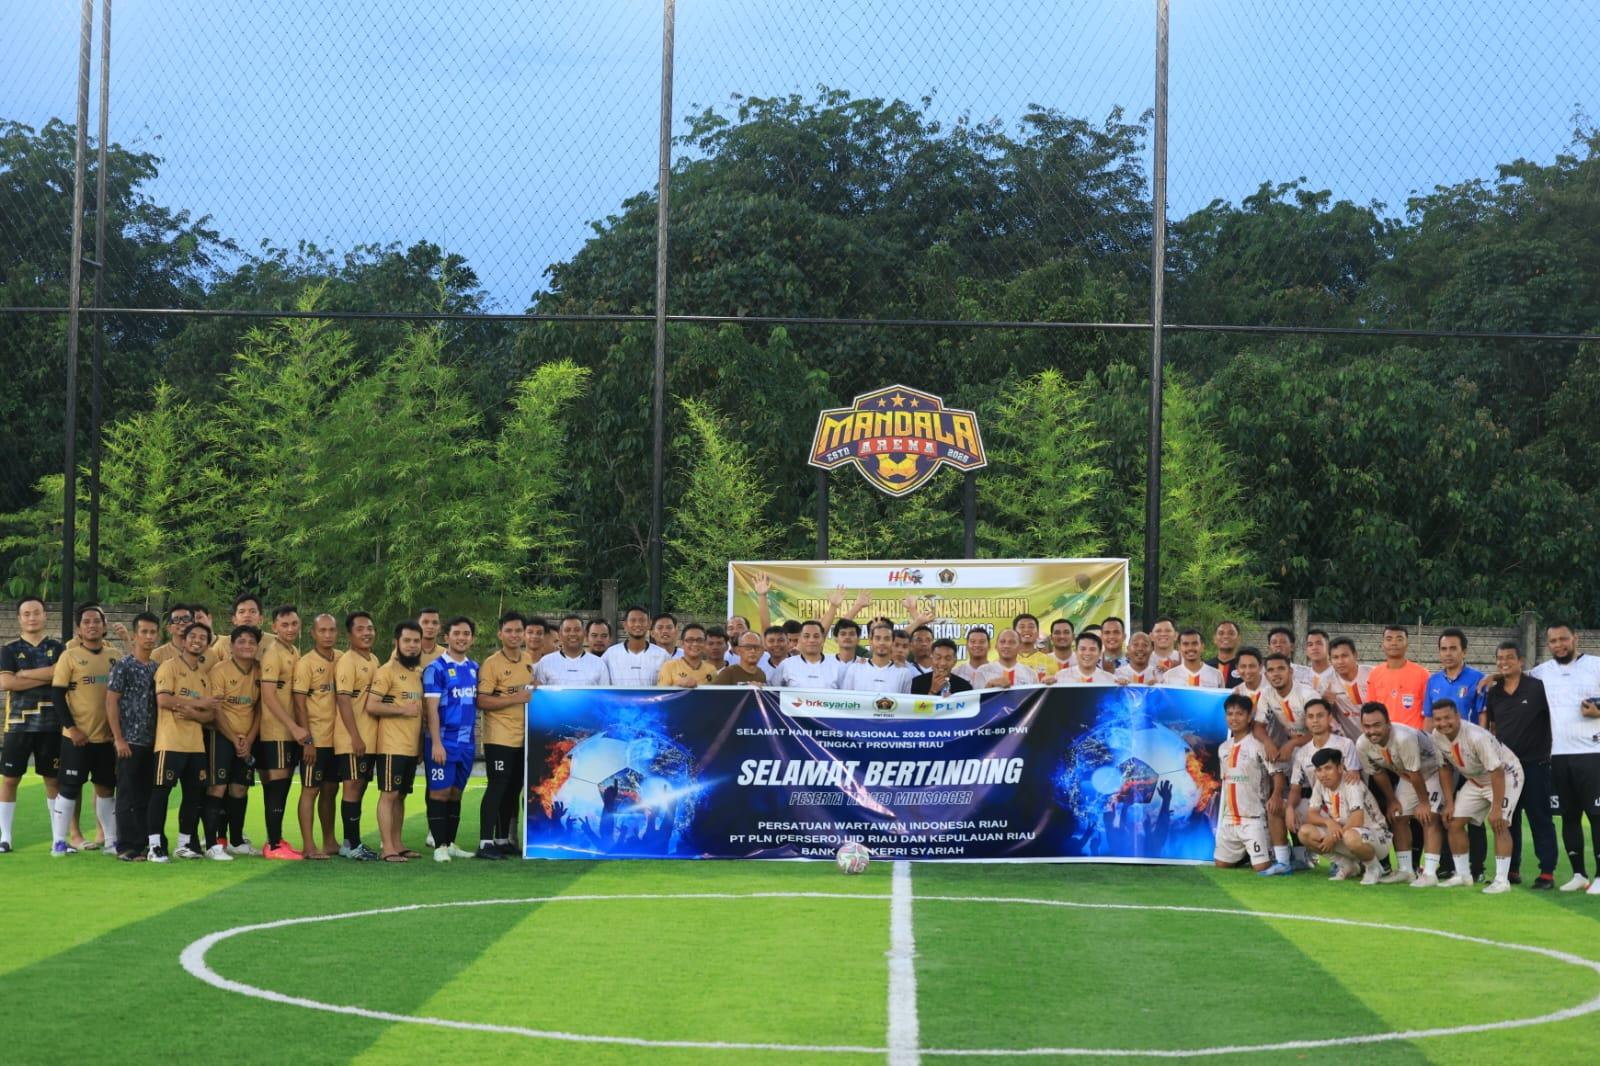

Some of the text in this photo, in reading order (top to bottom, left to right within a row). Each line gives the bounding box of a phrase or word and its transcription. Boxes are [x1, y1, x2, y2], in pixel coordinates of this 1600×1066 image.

[818, 411, 979, 456] MANDALA
[860, 439, 935, 454] ARENA
[827, 447, 850, 462] ESTD
[874, 599, 900, 618] HARI
[936, 599, 993, 618] NASIONAL
[996, 598, 1029, 618] (HPN)
[933, 623, 962, 640] RIAU
[806, 699, 861, 711] brksyariah
[935, 701, 966, 711] PLN
[736, 728, 786, 736] SELAMAT
[788, 729, 813, 737] HARI
[815, 730, 844, 738] PERS
[846, 730, 899, 738] NASIONAL
[953, 729, 974, 737] HUT
[1008, 726, 1028, 735] PWI
[819, 741, 944, 749] TINGKAT PROVINSI RIAU
[494, 760, 504, 770] 12
[431, 768, 445, 780] 28
[737, 757, 1024, 786] SELAMAT BERTANDING
[789, 791, 844, 806] PESERTA
[894, 791, 973, 806] MINISOCCER
[758, 819, 1008, 831] PERSATUAN WARTAWAN INDONESIA RIAU
[729, 831, 1036, 844] PT PLN (PERSERO) UID RIAU DAN KEPULAUAN RIAU
[801, 846, 964, 856] BANK KEPRI SYARIAH
[1253, 841, 1261, 853] 6
